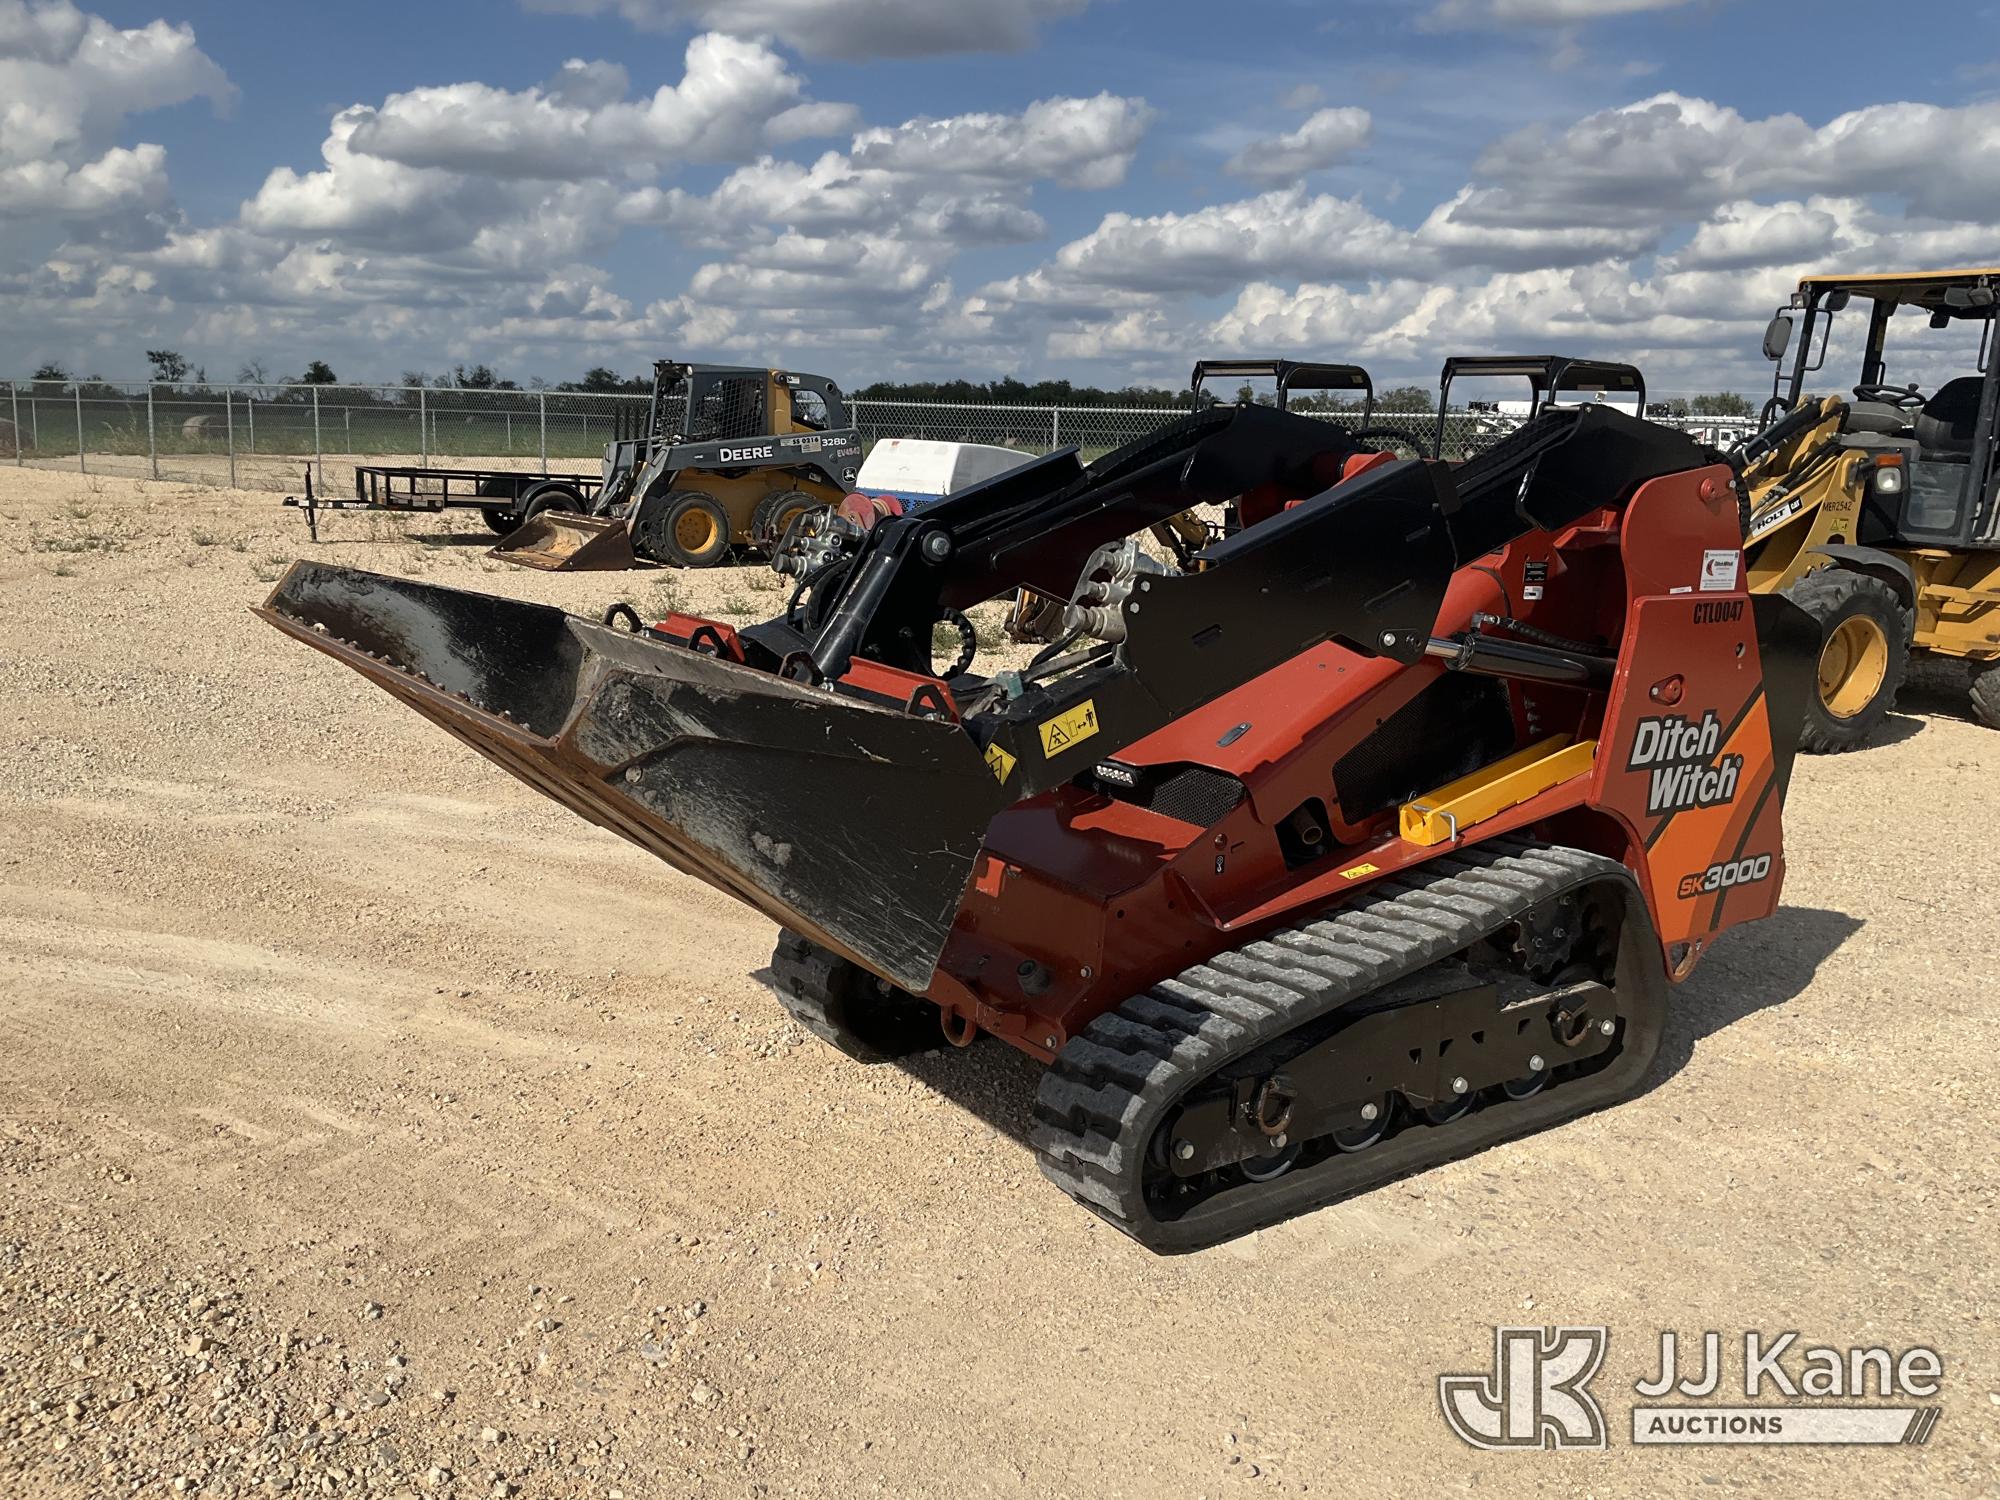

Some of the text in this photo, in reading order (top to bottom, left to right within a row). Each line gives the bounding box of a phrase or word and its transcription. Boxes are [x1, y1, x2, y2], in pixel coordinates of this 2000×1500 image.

[719, 445, 773, 462] DEERE
[821, 437, 847, 447] 328D
[1823, 501, 1852, 512] MER2542
[1757, 508, 1786, 530] HOLT
[1693, 600, 1744, 625] CTL0047
[1630, 714, 1719, 766] Ditch
[1649, 758, 1738, 811] Witch
[1679, 855, 1771, 897] SK3000
